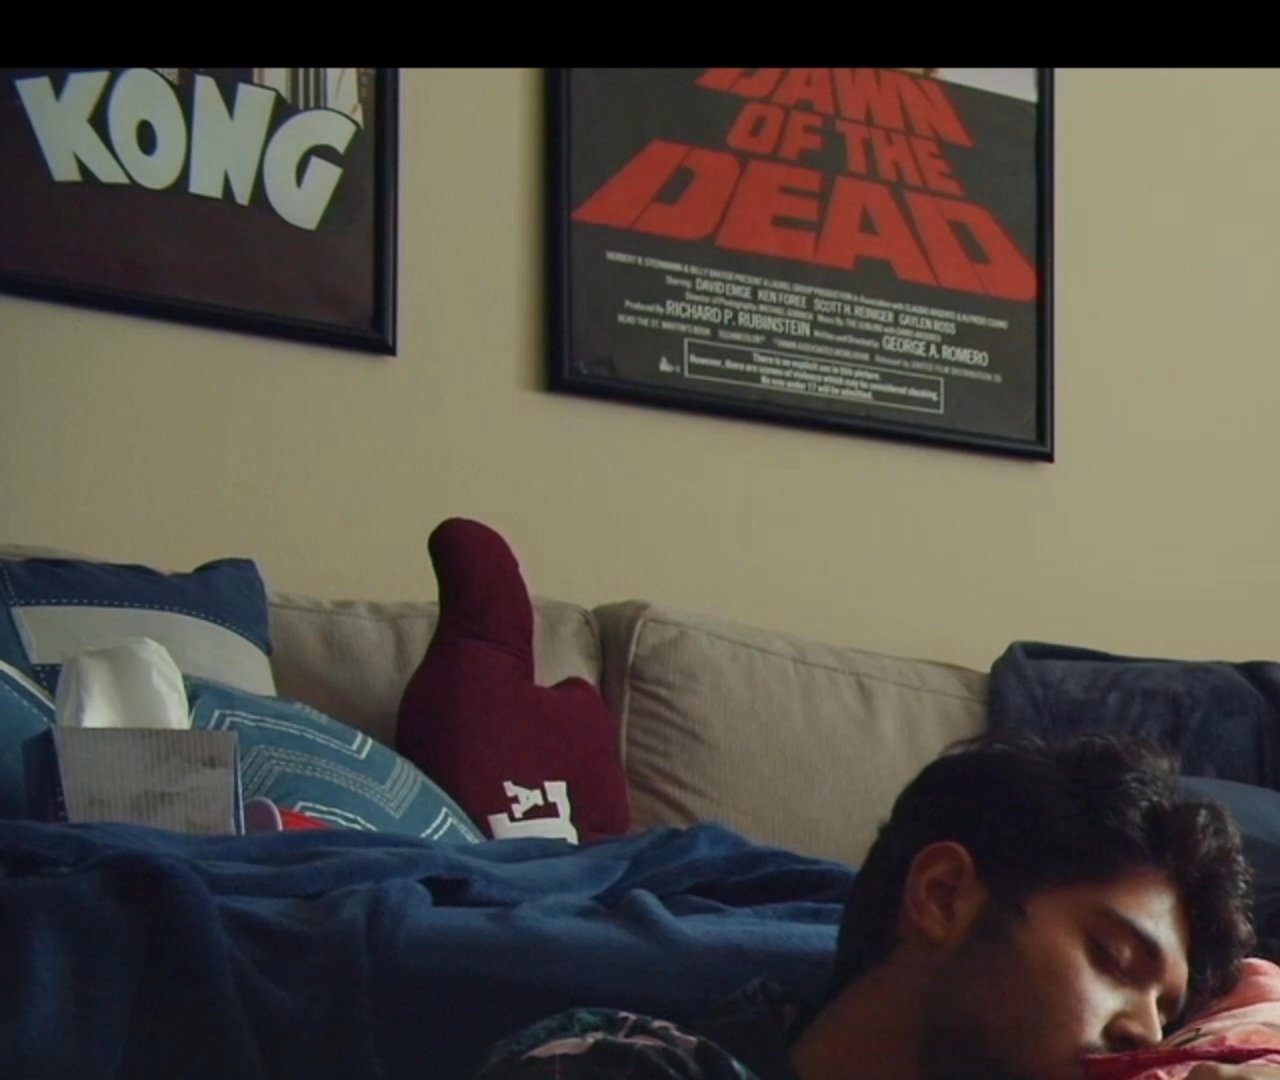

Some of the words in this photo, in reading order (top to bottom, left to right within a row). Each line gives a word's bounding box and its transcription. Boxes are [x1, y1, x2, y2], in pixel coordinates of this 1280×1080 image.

[14, 68, 358, 230] KONG
[726, 101, 825, 161] OF
[834, 117, 967, 197] THE
[570, 139, 1039, 302] DEAD
[666, 300, 722, 324] RICHARD
[723, 309, 736, 326] P.
[738, 310, 811, 337] RUBINSTEIN
[882, 335, 927, 357] GEORGE
[941, 344, 989, 368] ROMERO
